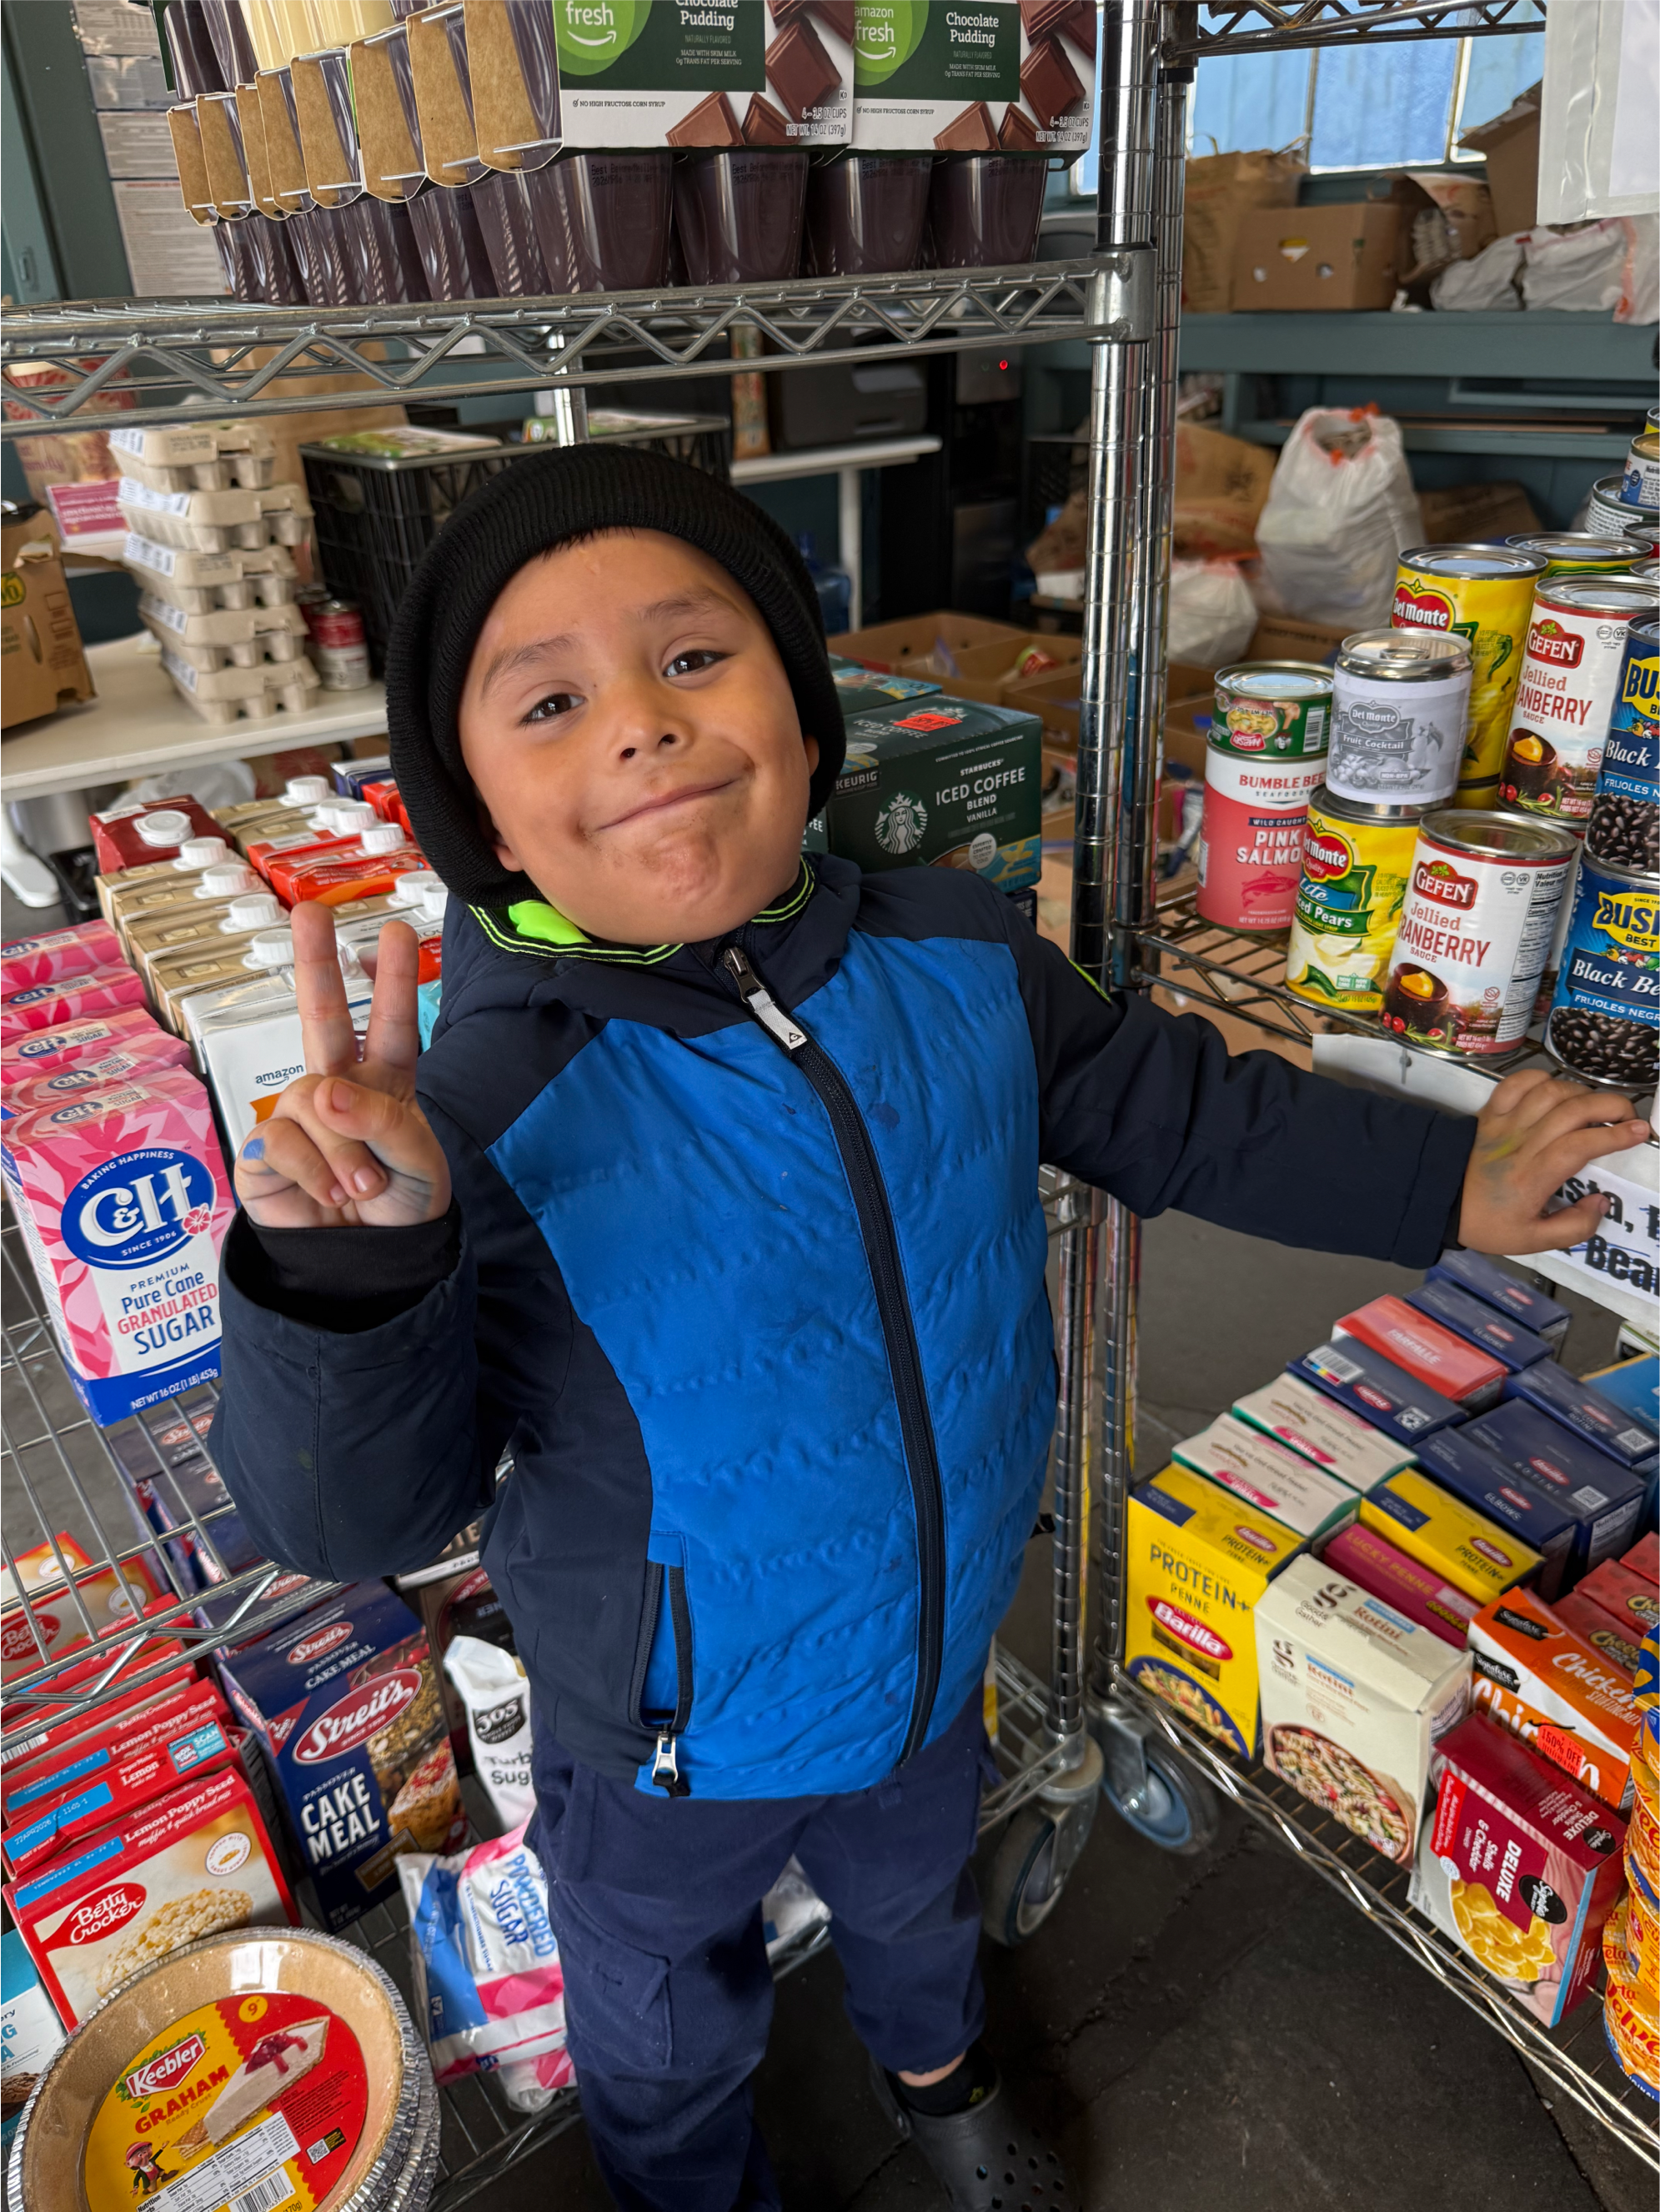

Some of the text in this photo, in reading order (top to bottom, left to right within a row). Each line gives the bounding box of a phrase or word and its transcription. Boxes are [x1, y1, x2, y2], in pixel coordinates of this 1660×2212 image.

[565, 4, 614, 26] fresh
[680, 11, 734, 31] Pudding
[855, 8, 894, 18] amazon
[946, 13, 999, 28] Chocolate
[685, 35, 730, 44] NATURALLY FLAVORED
[855, 22, 894, 42] fresh
[950, 28, 995, 47] Pudding
[786, 124, 798, 136] NET
[811, 124, 819, 136] 14
[828, 123, 846, 137] (397g)
[1036, 132, 1046, 142] NET
[1392, 597, 1448, 627] Del Monte
[1528, 629, 1577, 661] GEFEN
[1523, 665, 1567, 692] Jellied
[1353, 709, 1396, 723] Del Monte
[1522, 710, 1545, 725] SAUCE
[1343, 734, 1403, 749] Fruit Cocktail
[1606, 739, 1649, 767] Black
[835, 770, 879, 790] KEURIG
[960, 759, 1004, 776] STARBUCKS
[1239, 775, 1300, 789] BUMBLE
[935, 767, 1026, 805] ICED COFFEE
[1604, 778, 1649, 795] FRIJOLES
[966, 807, 997, 824] VANILLA
[967, 794, 997, 810] BLEND
[1276, 817, 1306, 825] CAUGHT
[1255, 829, 1301, 847] PINK
[1236, 846, 1301, 865] SALMO
[1299, 877, 1329, 901] Lite
[1416, 867, 1470, 903] GEFEN
[1537, 870, 1562, 880] Nutrition
[1411, 902, 1461, 931] Jellied
[1410, 947, 1437, 964] SAUCE
[1626, 934, 1656, 947] BEST
[1572, 959, 1628, 989] Black
[1573, 994, 1660, 1022] FRIJOLES NEGR
[76, 1031, 103, 1043] SUGAR
[255, 1064, 304, 1085] amazon
[81, 1150, 175, 1191] BAKING HAPPINESS
[79, 1161, 193, 1247] C&H
[122, 1231, 177, 1256] SINCE 1906
[130, 1263, 190, 1292] PREMIUM
[122, 1272, 205, 1314] Pure Cane
[118, 1282, 218, 1335] GRANULATED
[133, 1305, 216, 1356] SUGAR
[1388, 1329, 1442, 1365] FARFALLE
[130, 1395, 147, 1410] NET
[146, 1390, 159, 1404] WT
[159, 1387, 168, 1399] 16
[168, 1382, 181, 1397] OZ
[201, 1367, 218, 1386] 453g
[1531, 1457, 1568, 1485] Barilla
[1484, 1492, 1523, 1522] ELBOWS
[1221, 1534, 1271, 1566] PROTEIN+
[1346, 1532, 1436, 1597] LUCKY PENNE
[1456, 1545, 1506, 1582] PROTEIN+
[1150, 1543, 1251, 1612] PROTEIN+
[1171, 1584, 1211, 1613] PENNE
[1154, 1602, 1223, 1653] Barilla
[1355, 1607, 1403, 1640] Rotini
[288, 1625, 353, 1663] Streit's
[308, 1641, 359, 1675] PASSOVER
[304, 1644, 377, 1692] CAKE MEAL
[1475, 1653, 1513, 1682] Signature
[1552, 1653, 1635, 1708] Chicken
[110, 1696, 217, 1755] Lemon Poppy Seed
[301, 1678, 414, 1762] Streit's
[477, 1698, 519, 1734] 365
[193, 1728, 218, 1746] SCAN
[121, 1760, 160, 1786] Lemon
[302, 1767, 356, 1802] PASSOVER
[491, 1771, 529, 1785] Sug
[124, 1776, 236, 1842] Lemon Poppy Seed
[301, 1773, 371, 1833] CAKE
[306, 1811, 381, 1866] MEAL
[1562, 1811, 1599, 1841] DELUXE
[1469, 1828, 1487, 1873] Cheddar
[1482, 1840, 1498, 1872] Shells
[1495, 1838, 1522, 1904] DELUXE
[72, 1888, 128, 1927] Betty
[490, 1878, 530, 1947] SUGAR
[505, 1853, 557, 1957] POWDERED
[70, 1896, 145, 1945] Crocker
[130, 2039, 201, 2096] Keebler
[135, 2064, 231, 2136] GRAHAM
[166, 2093, 213, 2126] Ready Crust
[138, 2194, 162, 2212] Nutrition
